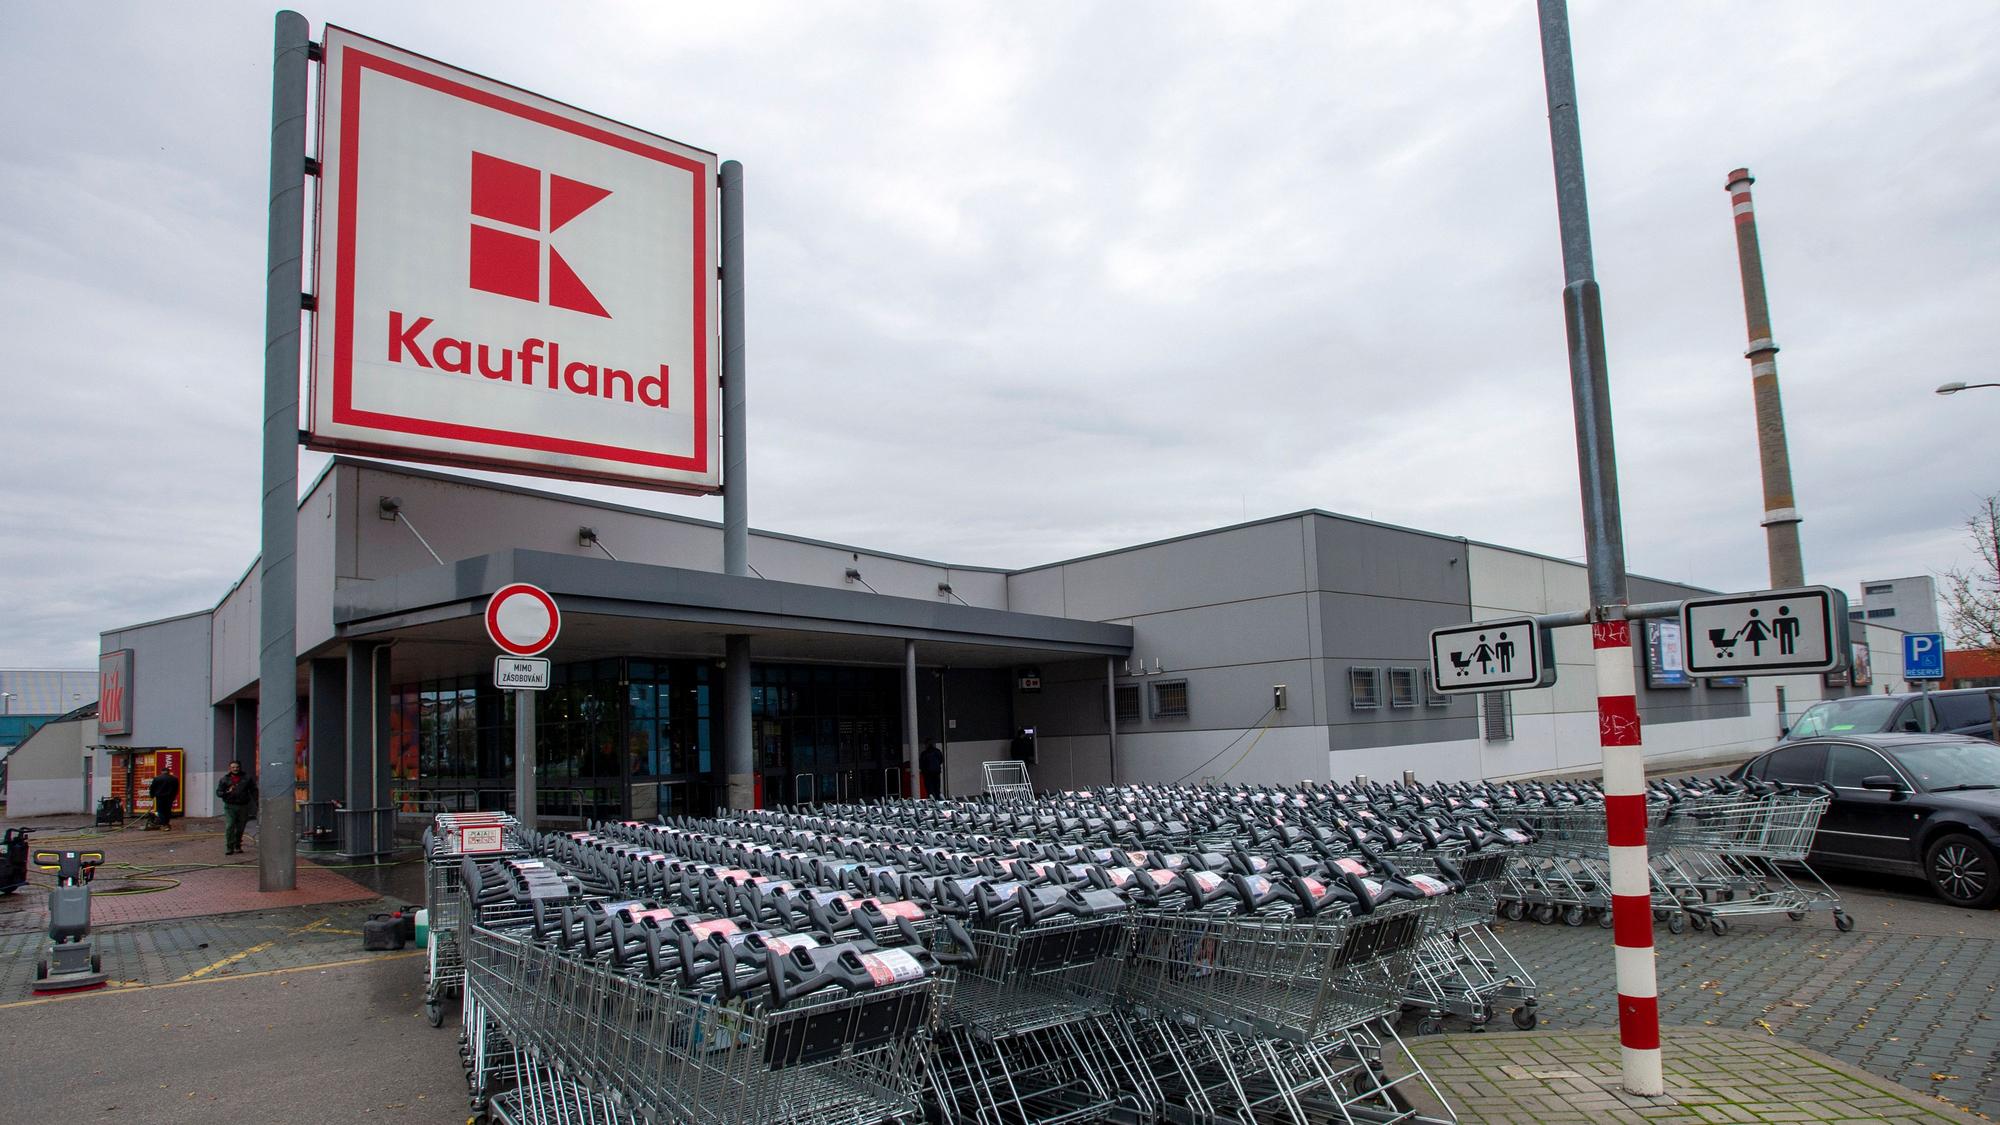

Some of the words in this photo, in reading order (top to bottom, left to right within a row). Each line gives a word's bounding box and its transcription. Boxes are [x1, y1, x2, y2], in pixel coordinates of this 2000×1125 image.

[388, 310, 669, 409] Kaufland
[1913, 637, 1932, 661] P
[514, 664, 532, 672] MIMO
[503, 672, 544, 683] ZÁSOBOVÁNÍ
